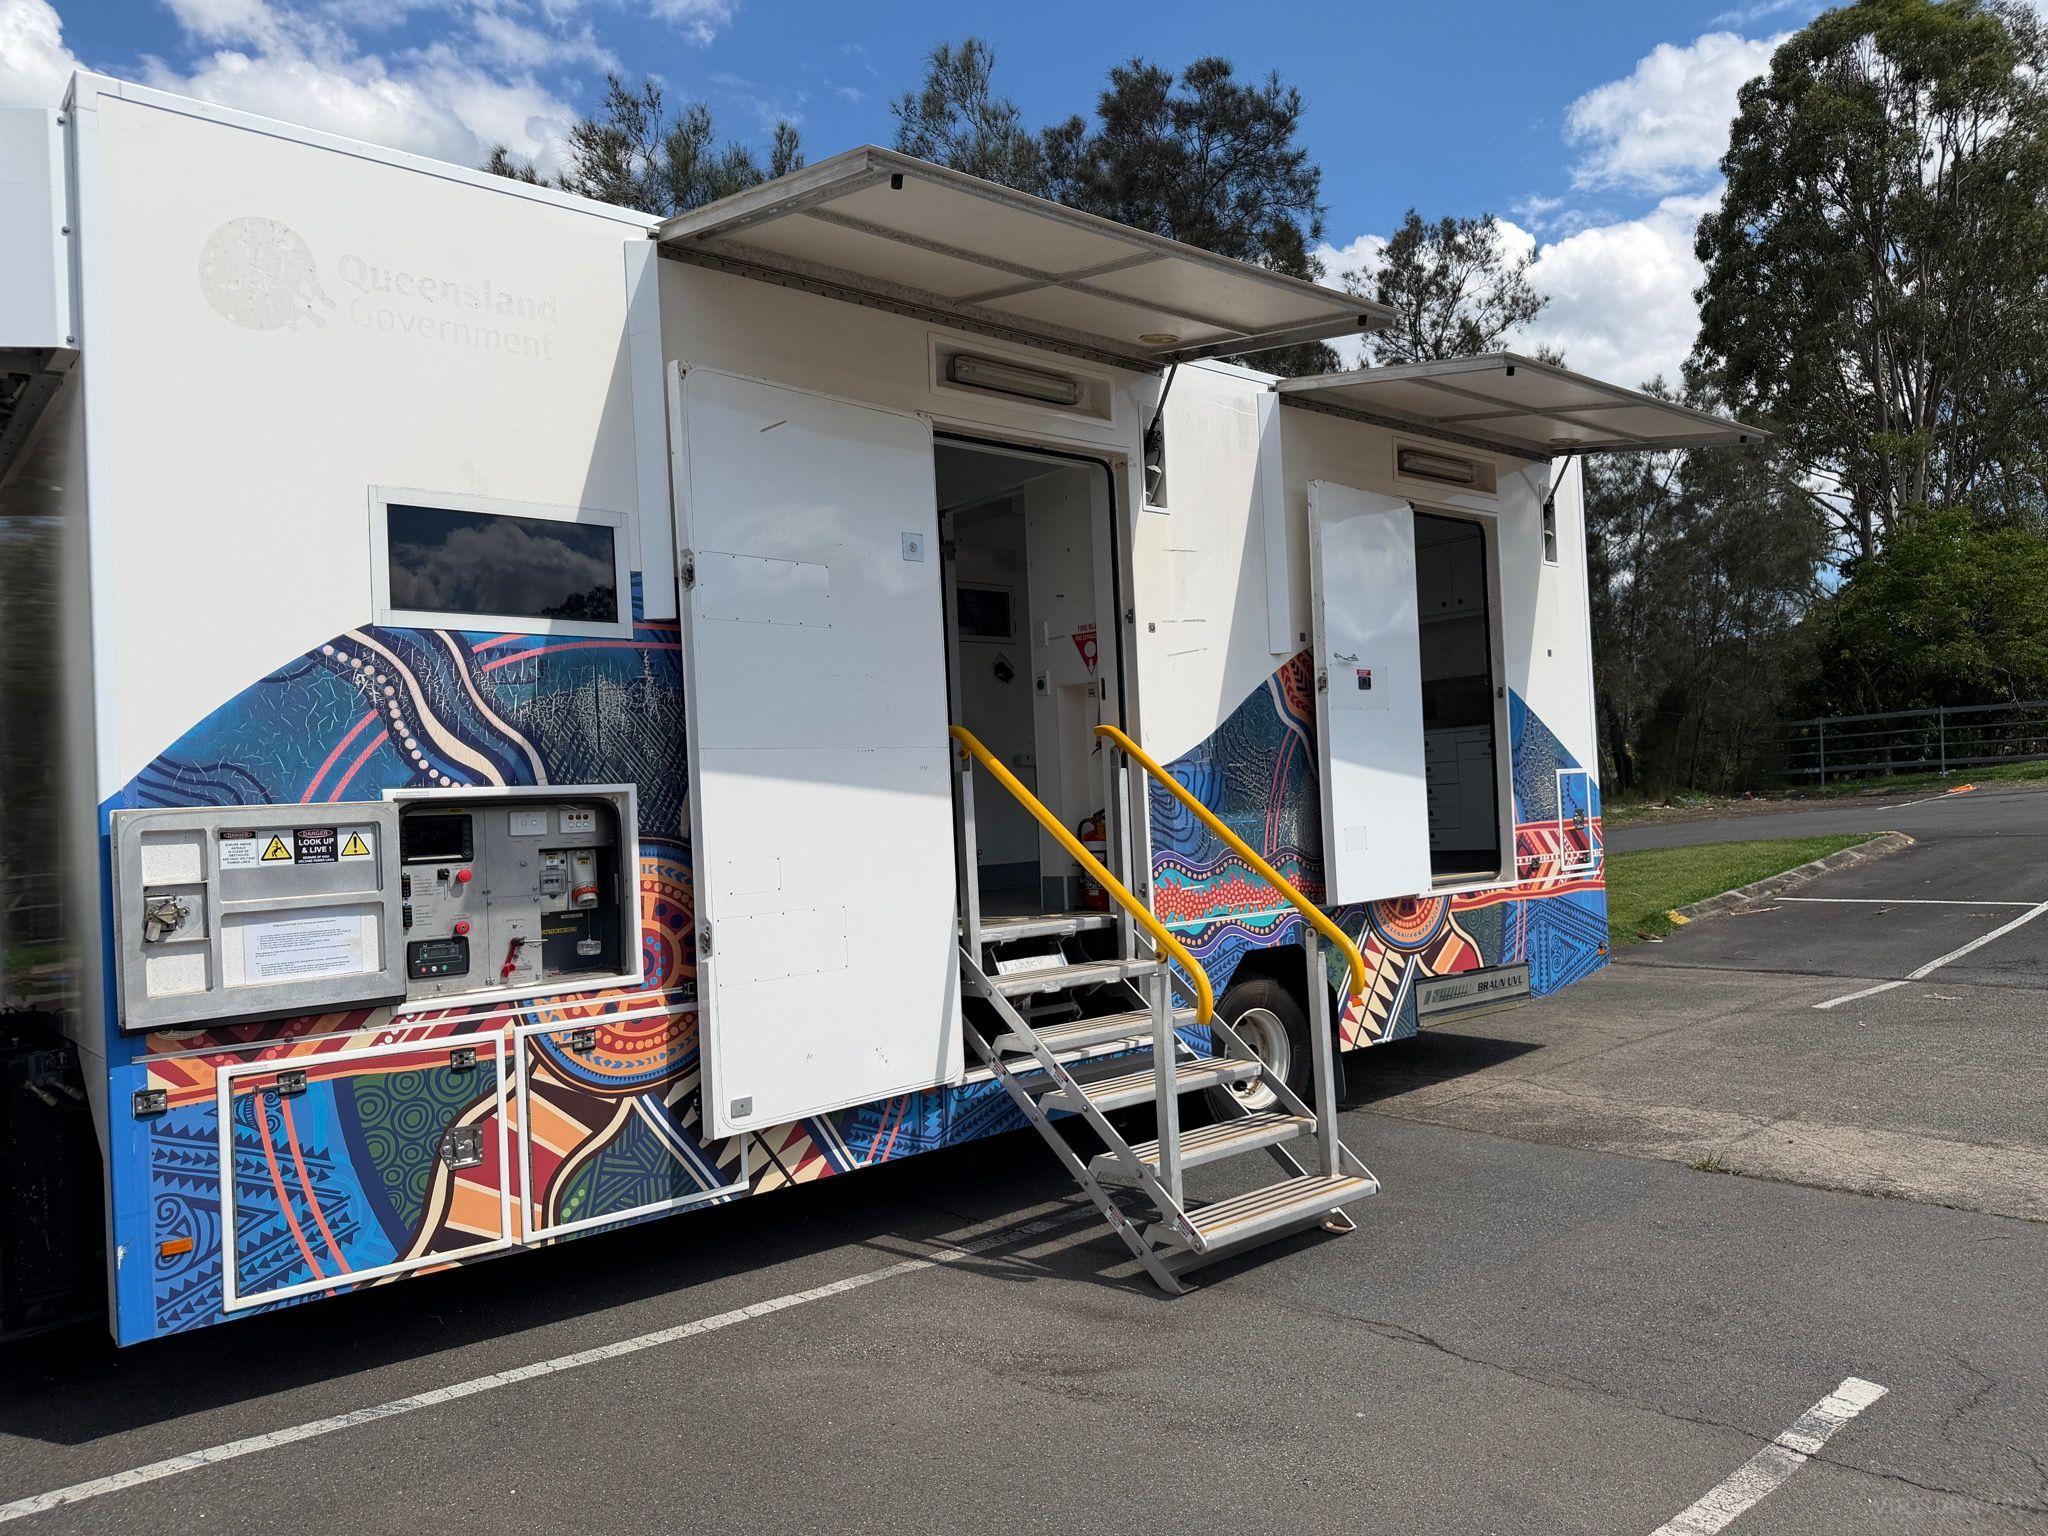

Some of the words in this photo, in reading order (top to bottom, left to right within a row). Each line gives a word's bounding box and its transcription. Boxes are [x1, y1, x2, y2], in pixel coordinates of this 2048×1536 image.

[338, 254, 558, 324] Queensland
[350, 298, 553, 361] Government
[298, 838, 322, 846] LOOK
[323, 837, 335, 845] UP
[309, 845, 327, 853] LIVE
[1477, 977, 1506, 991] BRAUN
